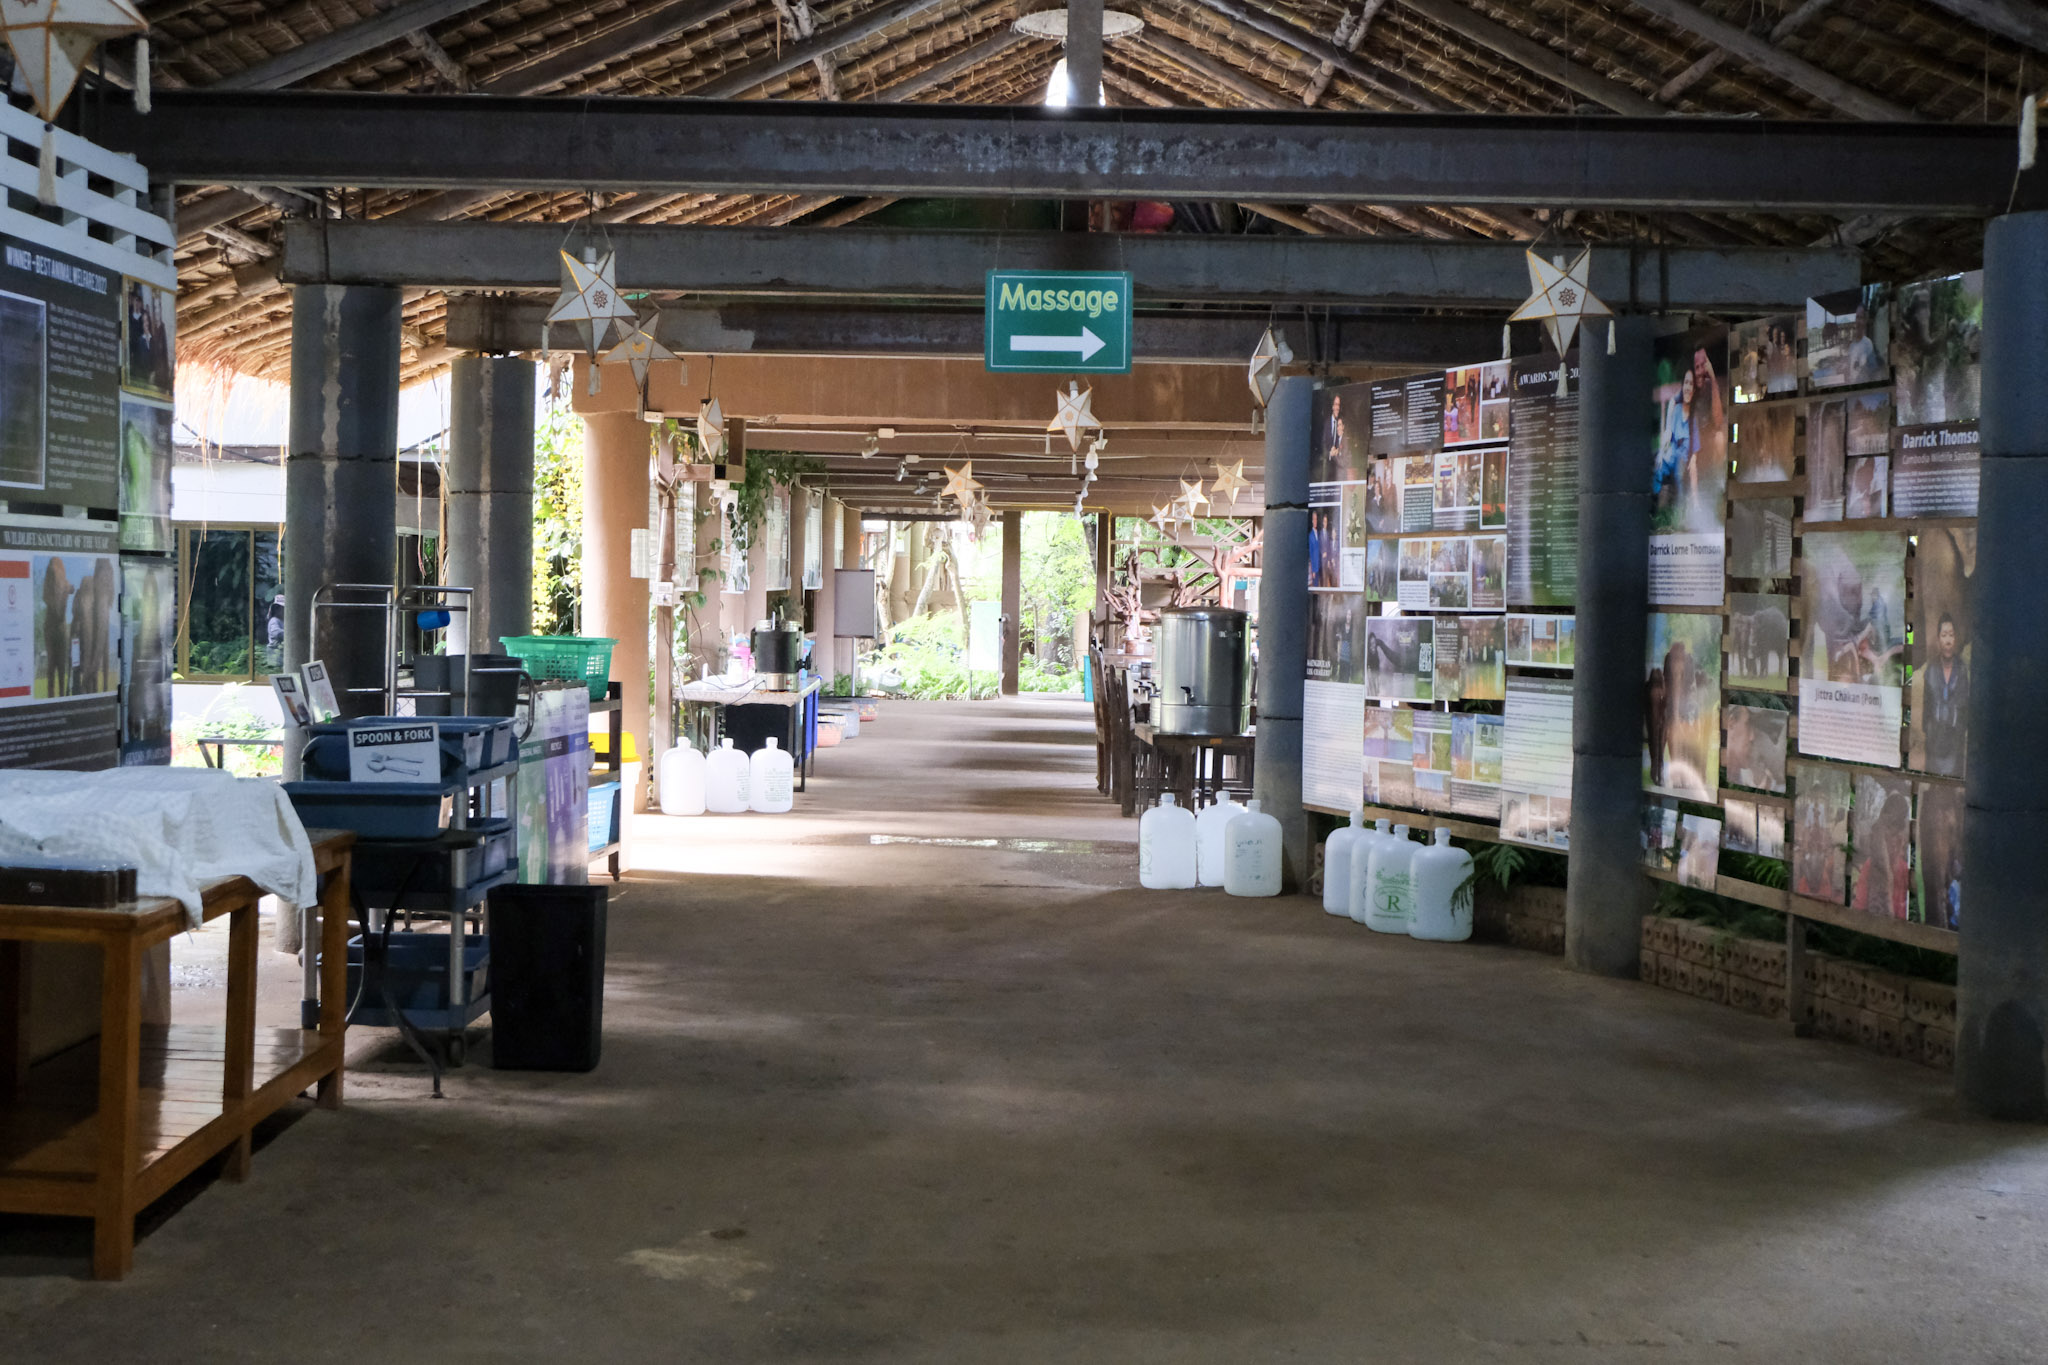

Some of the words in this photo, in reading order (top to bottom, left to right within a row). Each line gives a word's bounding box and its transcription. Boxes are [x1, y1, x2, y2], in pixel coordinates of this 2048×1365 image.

[6, 245, 32, 272] WINNER
[36, 254, 52, 277] BEST
[998, 282, 1119, 318] Massage
[1519, 371, 1548, 386] AWARDS
[1902, 430, 1938, 449] Darrick
[1939, 428, 1979, 446] Thomso
[4, 530, 38, 546] WILDLIFE
[38, 532, 73, 548] SANCTUARY
[1649, 543, 1671, 556] Darrick
[1671, 543, 1689, 556] Lorne
[1690, 543, 1721, 556] Thomson
[355, 731, 392, 745] SPOON
[393, 730, 402, 742] &
[404, 728, 432, 741] FORK
[1387, 895, 1401, 912] R
